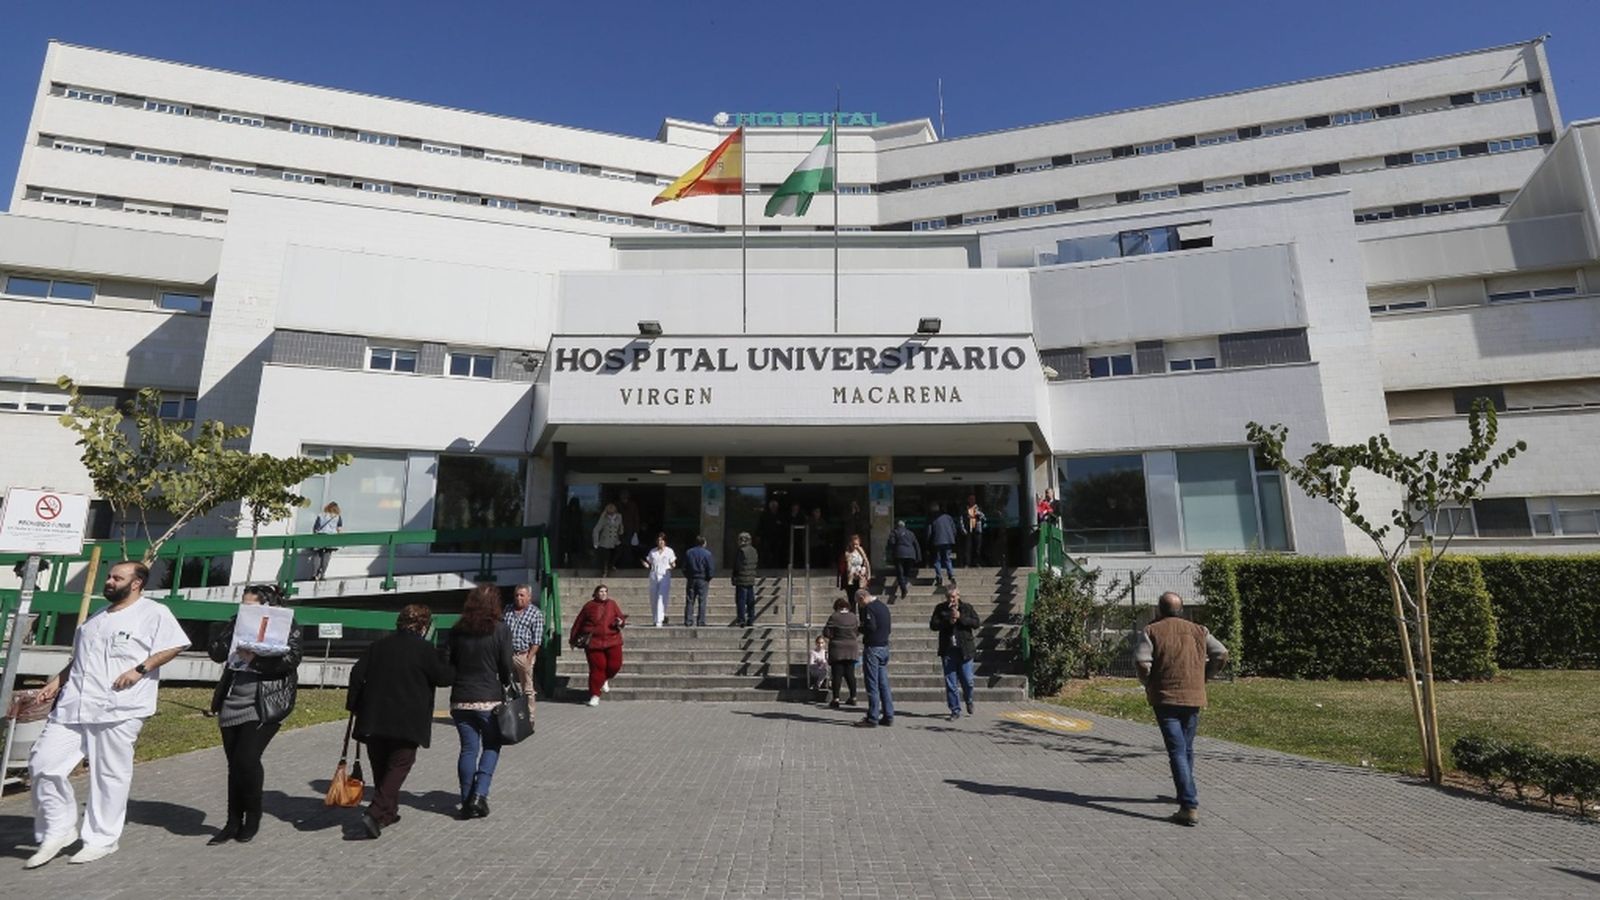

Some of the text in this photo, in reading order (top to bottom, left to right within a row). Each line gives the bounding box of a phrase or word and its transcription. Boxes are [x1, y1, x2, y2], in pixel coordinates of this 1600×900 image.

[735, 111, 887, 127] HOSPITAL
[556, 347, 1026, 372] HOSPITAL UNIVERSITARIO
[621, 386, 963, 405] VIRGEN MACARENA
